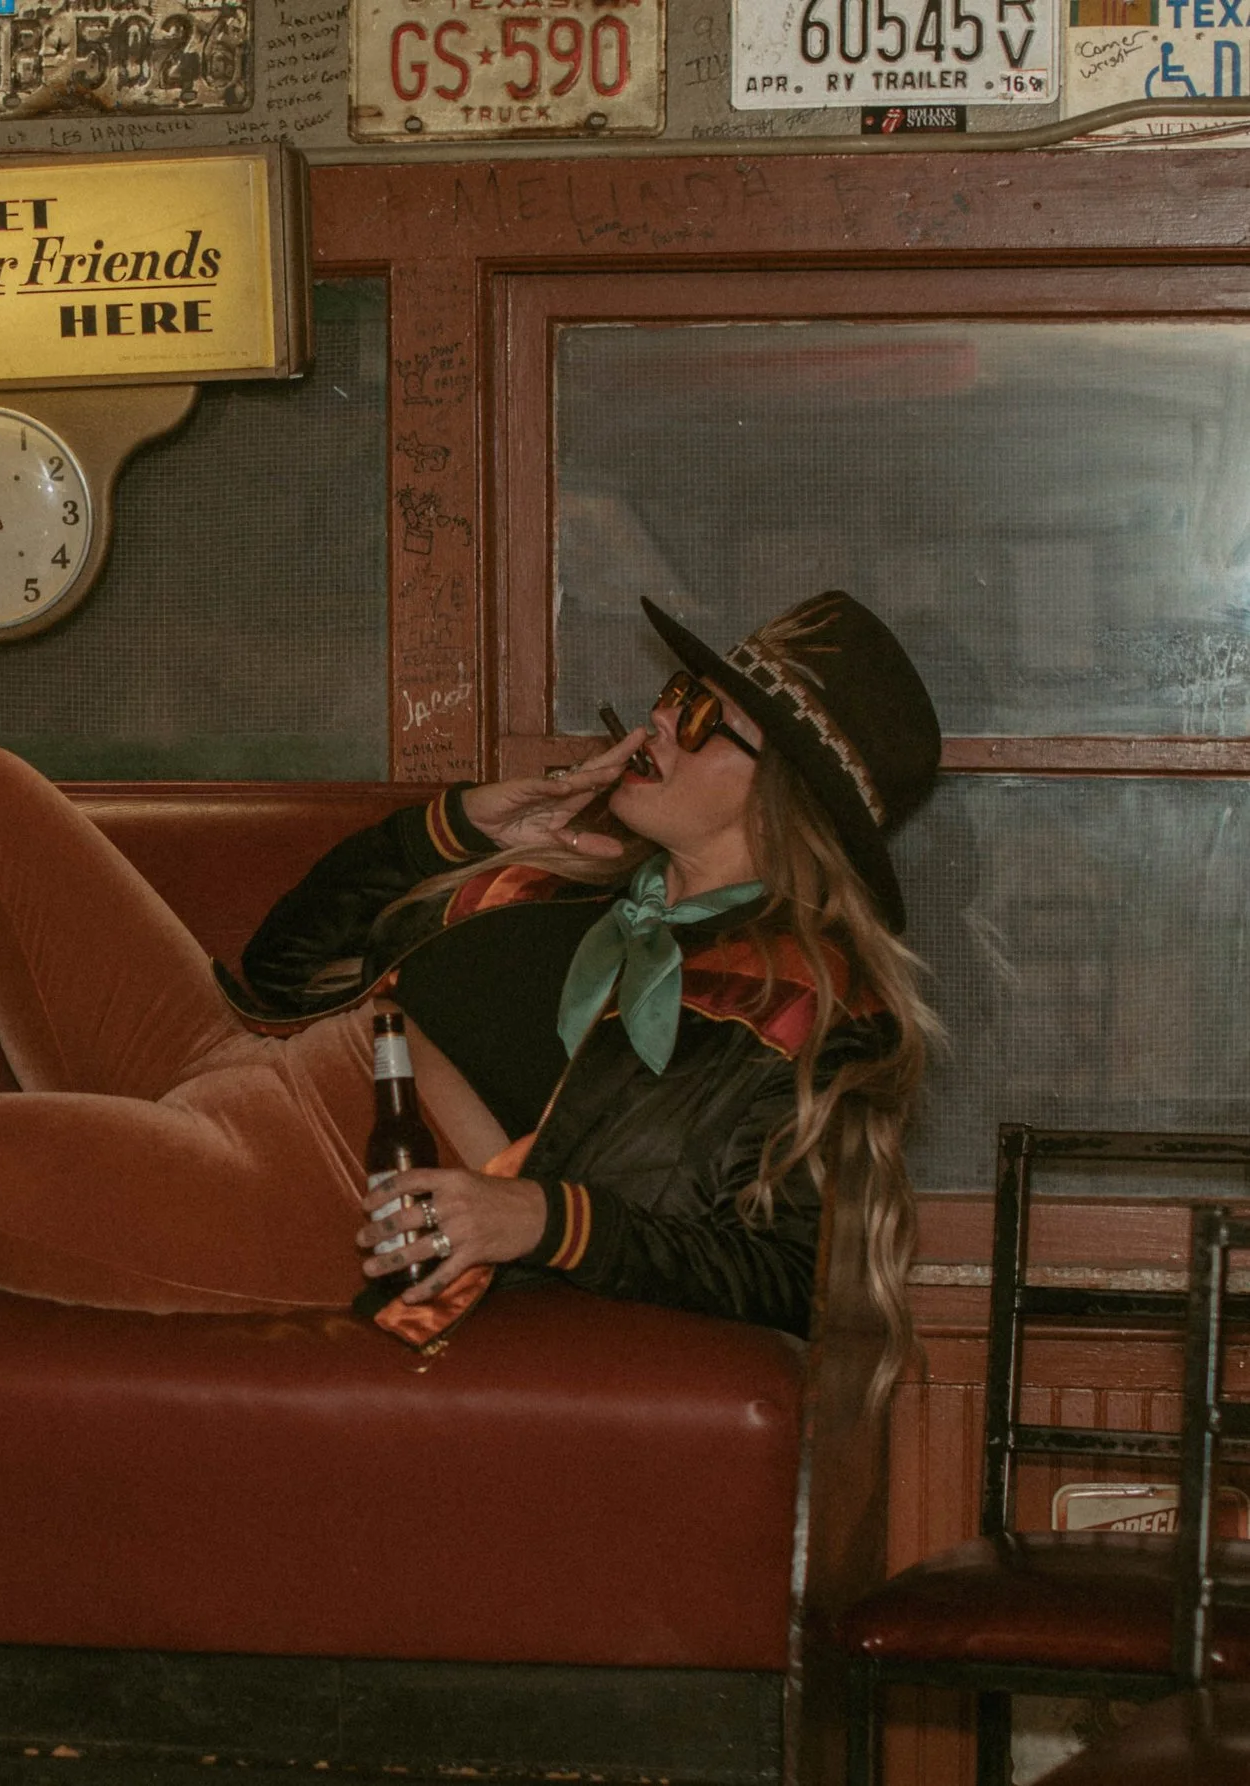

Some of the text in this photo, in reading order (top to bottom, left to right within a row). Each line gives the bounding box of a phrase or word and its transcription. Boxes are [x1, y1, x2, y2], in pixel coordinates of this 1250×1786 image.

[1166, 0, 1250, 28] TEX
[800, 0, 985, 65] 60545
[391, 19, 472, 102] GS
[501, 15, 631, 101] 590
[871, 70, 968, 92] TRAILER
[460, 105, 553, 125] TRUCK
[907, 108, 957, 119] ROLLING
[907, 116, 958, 128] STONES
[19, 229, 223, 287] Friends
[59, 299, 214, 338] HERE
[19, 426, 28, 452] 1
[47, 456, 65, 482] 2
[61, 499, 81, 526] 3
[51, 543, 71, 570] 4
[23, 577, 41, 603] 5
